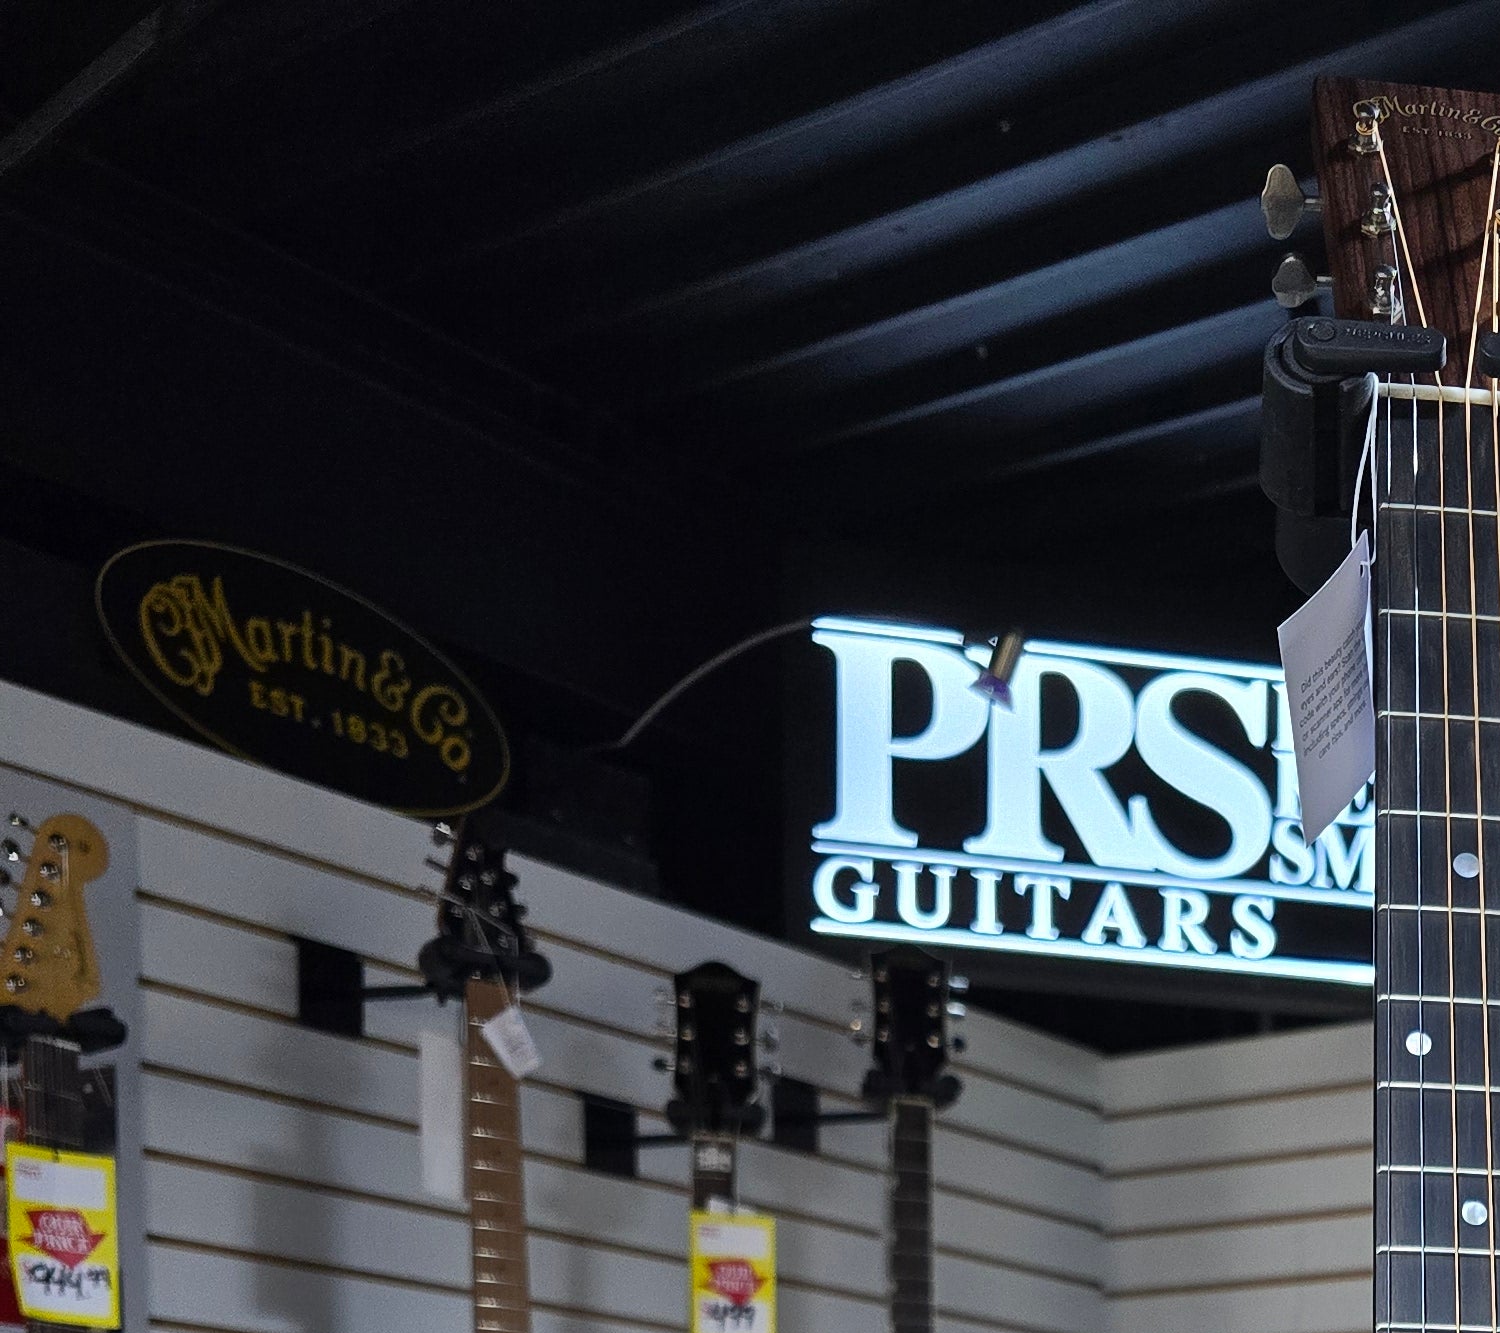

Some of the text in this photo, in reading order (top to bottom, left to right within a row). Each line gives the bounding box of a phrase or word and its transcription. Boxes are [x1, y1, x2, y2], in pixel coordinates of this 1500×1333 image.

[1301, 674, 1311, 693] Did
[1312, 663, 1323, 683] this
[1324, 646, 1343, 670] beauty
[1316, 679, 1326, 696] and
[1299, 709, 1314, 727] code
[1316, 694, 1328, 712] with
[1329, 682, 1340, 703] your
[811, 631, 1272, 880] PRS
[811, 856, 1279, 960] GUITARS
